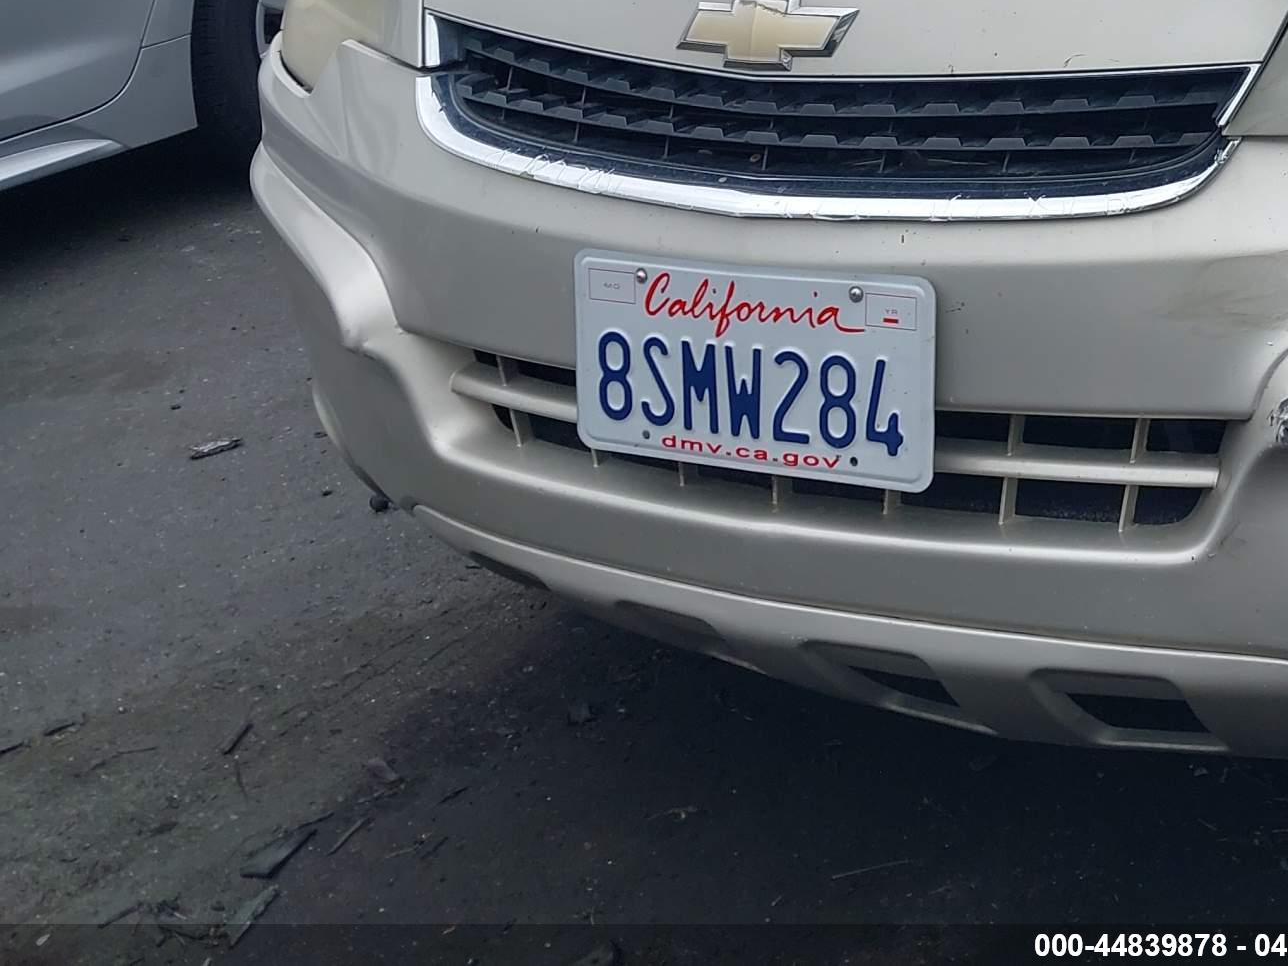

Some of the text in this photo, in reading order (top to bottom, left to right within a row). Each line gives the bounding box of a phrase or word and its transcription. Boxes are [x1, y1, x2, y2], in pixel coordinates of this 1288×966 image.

[644, 271, 866, 339] California
[598, 331, 904, 458] 8SMW284
[662, 434, 841, 469] dmv.ca.gov
